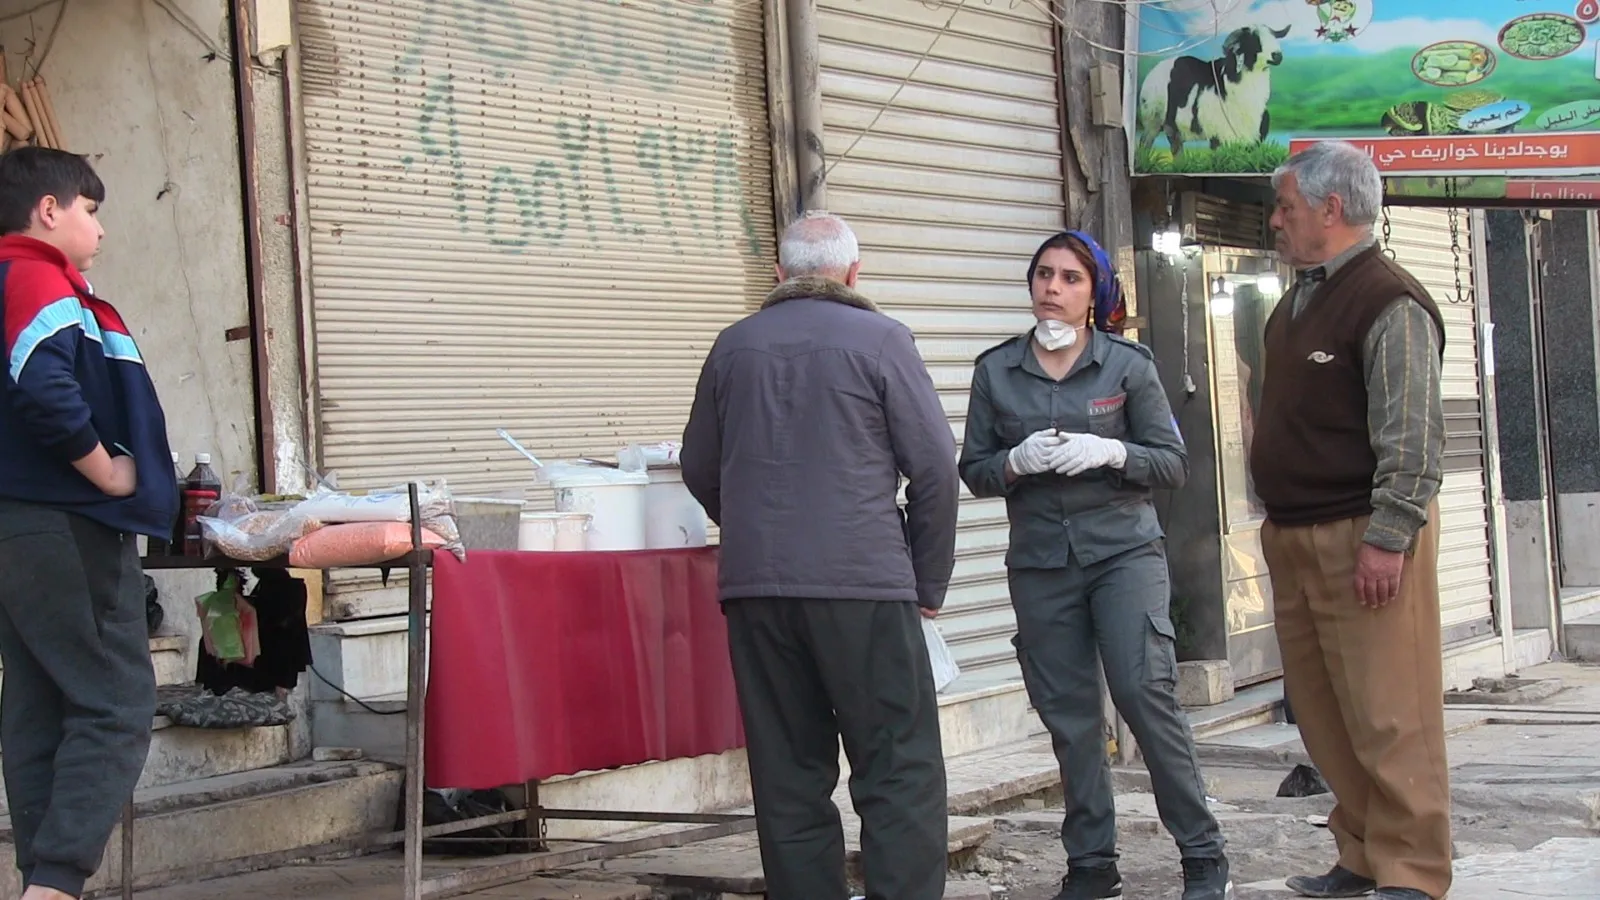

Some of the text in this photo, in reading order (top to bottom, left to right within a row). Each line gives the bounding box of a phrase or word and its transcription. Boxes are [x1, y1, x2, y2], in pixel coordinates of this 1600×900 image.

[1467, 112, 1502, 130] بعجين
[1543, 110, 1578, 130] البلبل
[1378, 149, 1406, 166] حي
[1411, 143, 1479, 162] خواريف
